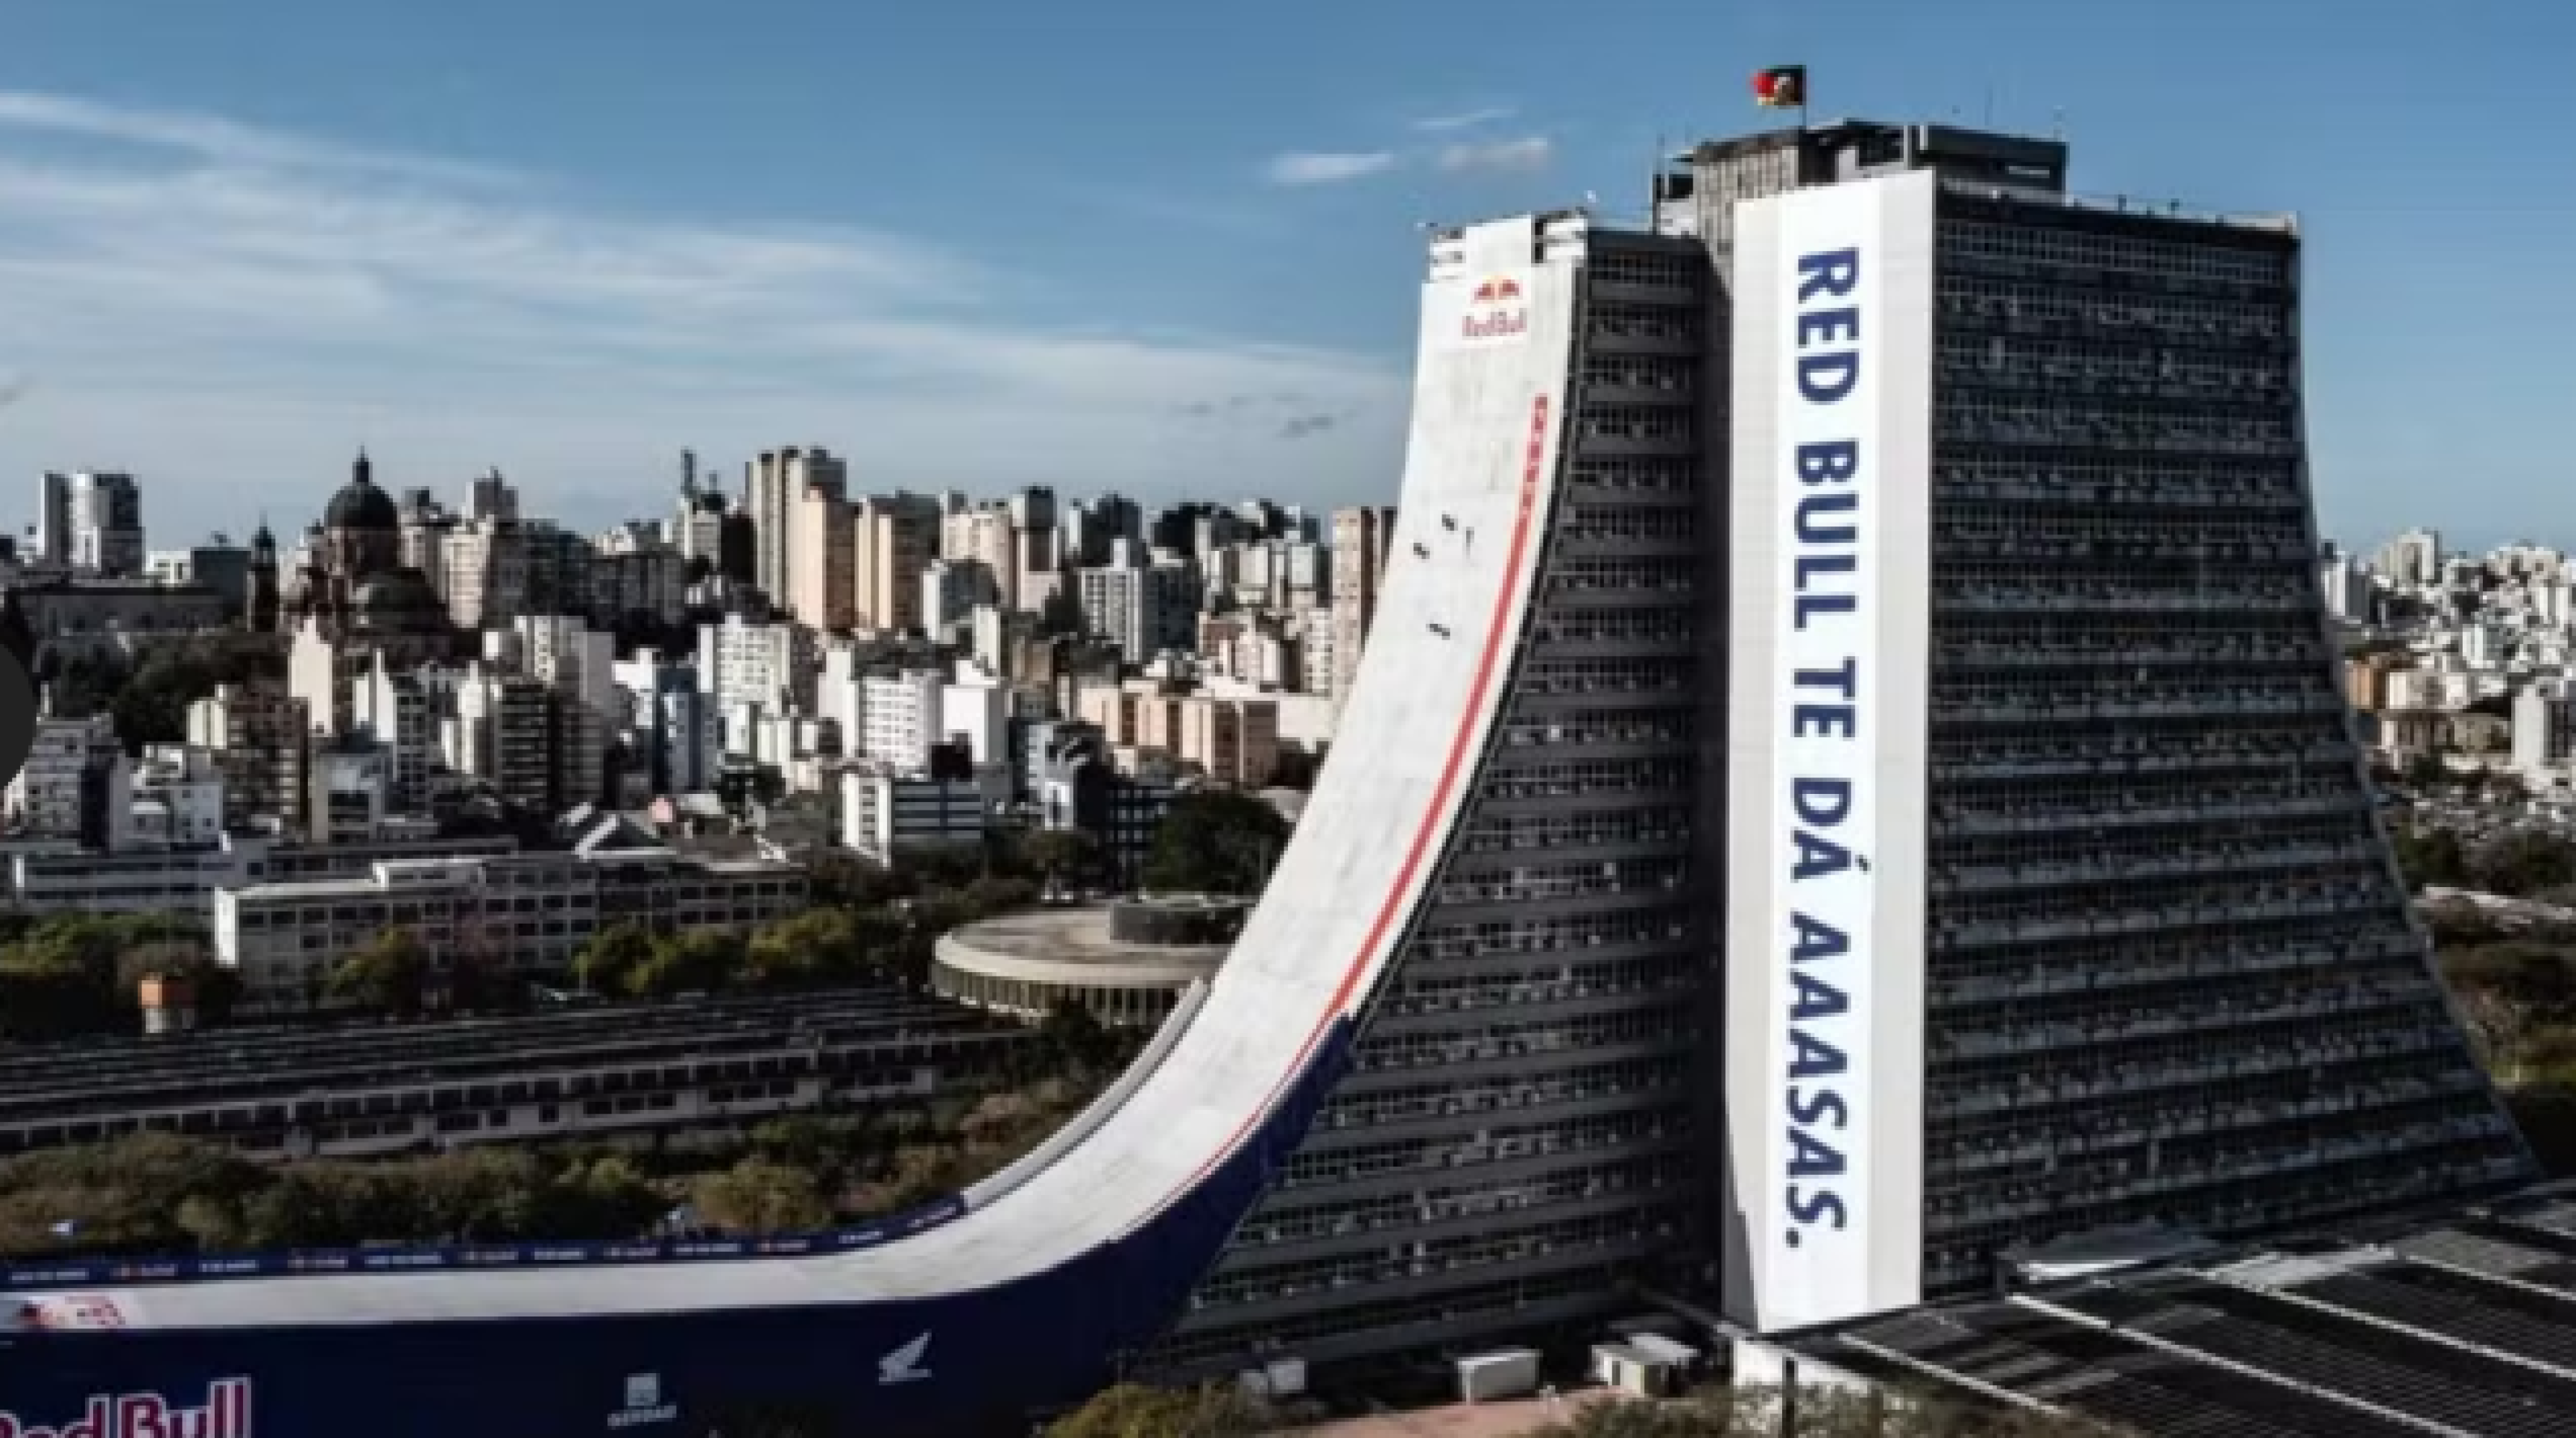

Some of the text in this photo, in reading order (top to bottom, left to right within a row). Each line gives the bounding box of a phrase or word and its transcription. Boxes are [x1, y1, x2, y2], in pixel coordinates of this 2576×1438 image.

[1786, 247, 1868, 1248] RED BULL TE DÁ AAASAS.
